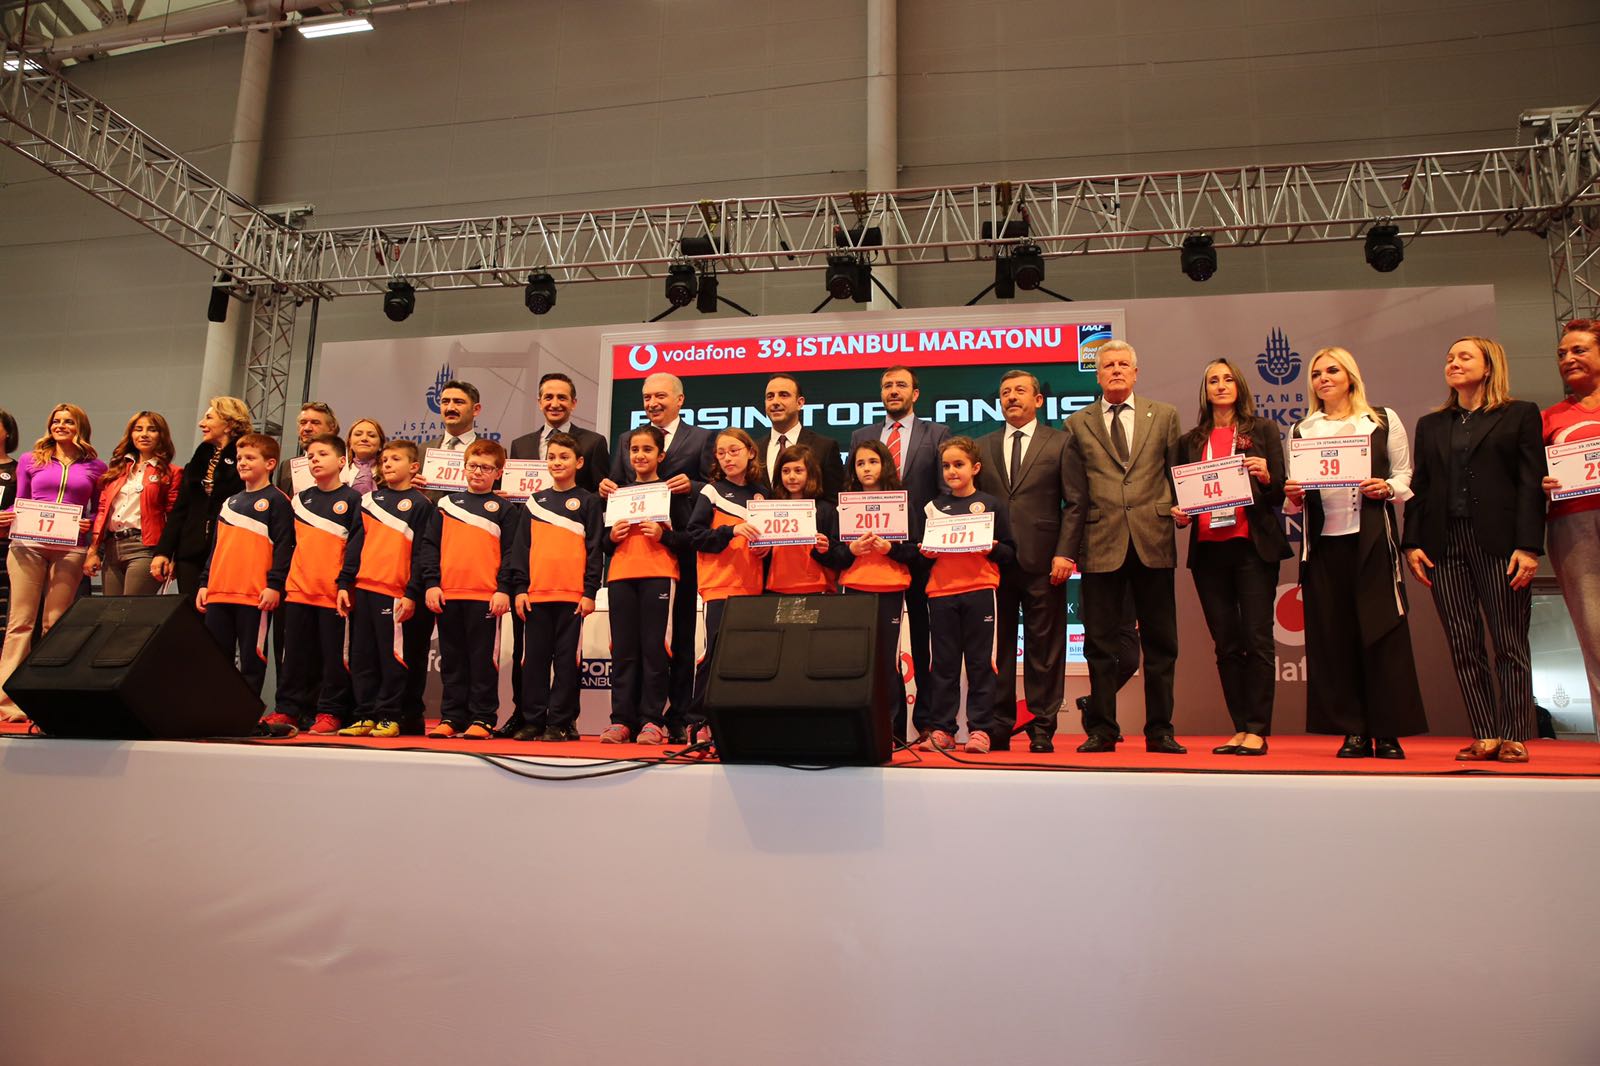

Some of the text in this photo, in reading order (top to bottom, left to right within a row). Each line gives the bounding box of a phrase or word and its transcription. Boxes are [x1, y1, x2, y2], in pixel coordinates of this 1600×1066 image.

[662, 344, 746, 362] vodafone
[757, 340, 792, 358] 39.
[918, 328, 1062, 351] MARATONU
[436, 467, 466, 480] 2071
[1320, 459, 1340, 476] 39
[520, 478, 542, 492] 542
[1204, 482, 1222, 498] 44
[630, 501, 646, 514] 34
[38, 518, 54, 532] 17
[764, 519, 799, 534] 2023
[856, 513, 890, 528] 2017
[942, 531, 974, 544] 1071
